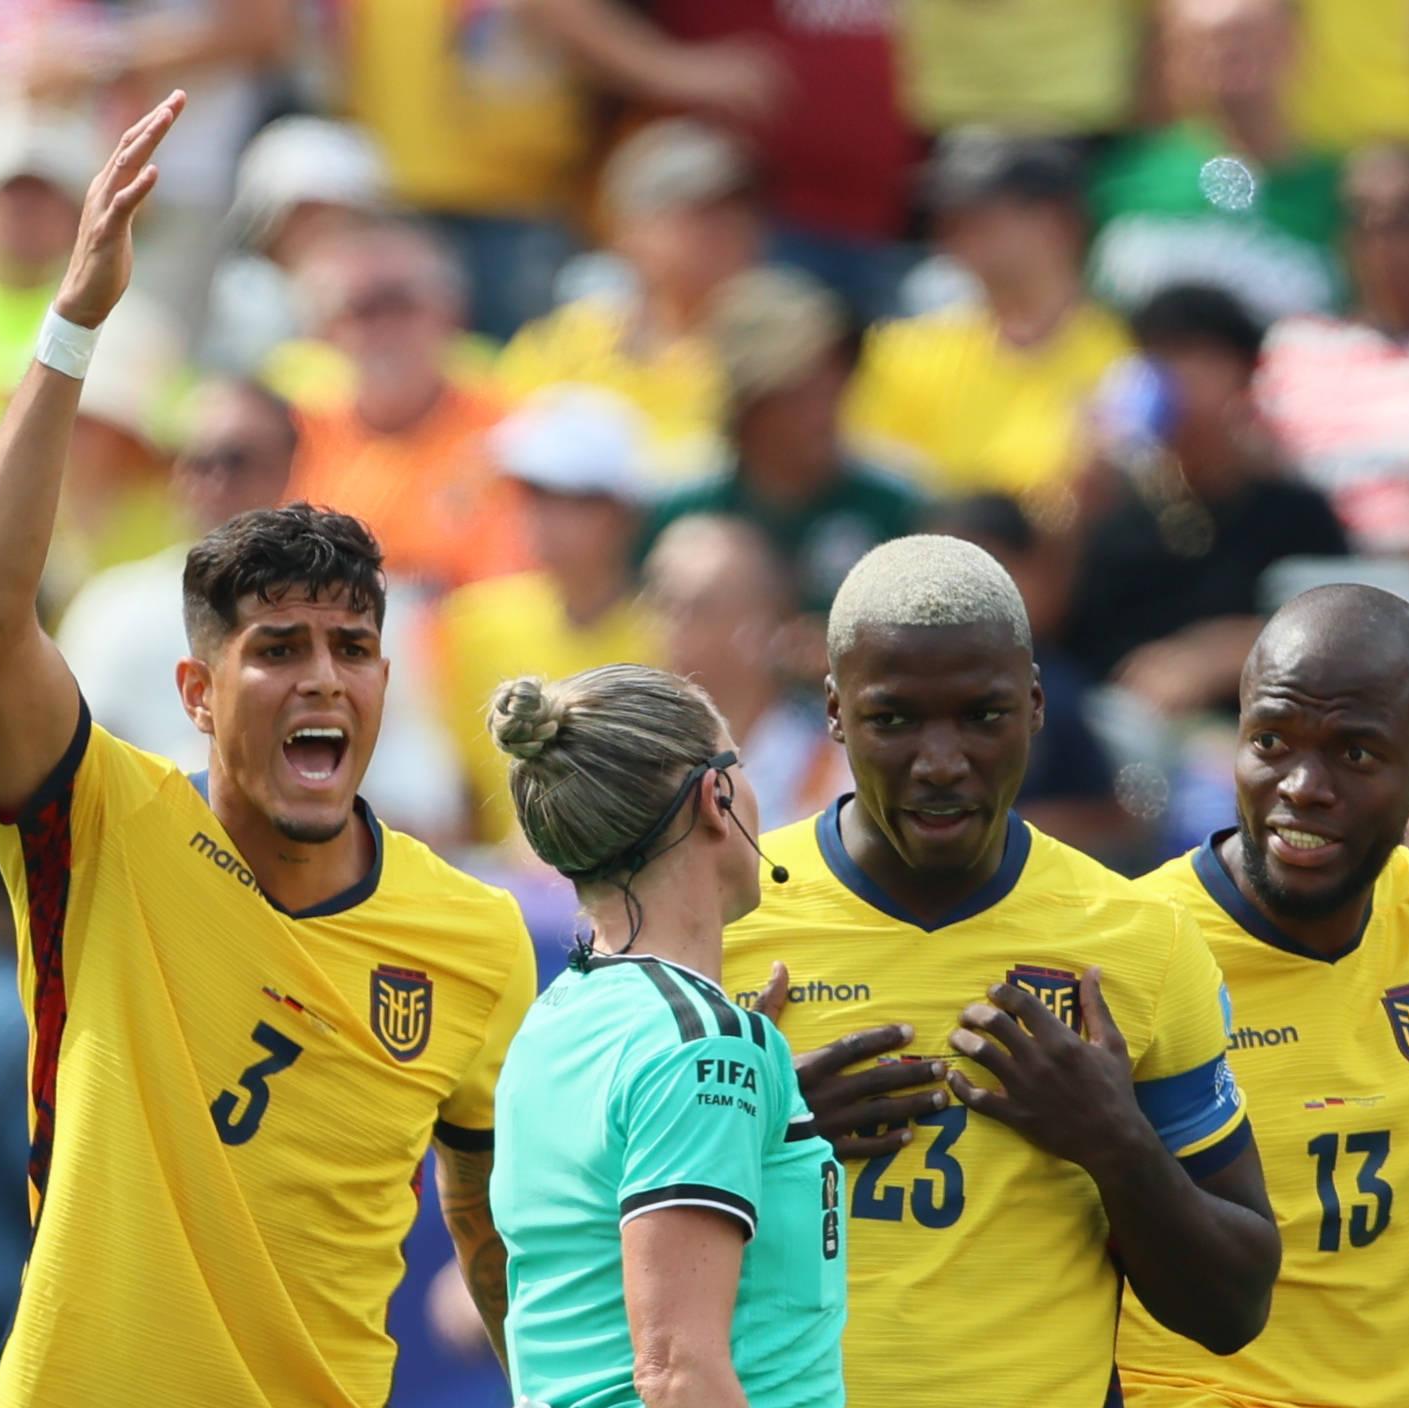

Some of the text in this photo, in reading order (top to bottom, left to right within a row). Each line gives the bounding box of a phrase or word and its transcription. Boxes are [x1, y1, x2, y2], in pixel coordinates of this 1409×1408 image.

[189, 832, 263, 897] mara
[736, 981, 870, 1010] mathon
[1226, 1026, 1300, 1051] athon
[210, 1020, 304, 1146] 3
[697, 1059, 757, 1095] FIFA
[697, 1093, 757, 1117] TEAM ONE
[850, 1105, 966, 1229] 23
[1308, 1130, 1393, 1253] 13
